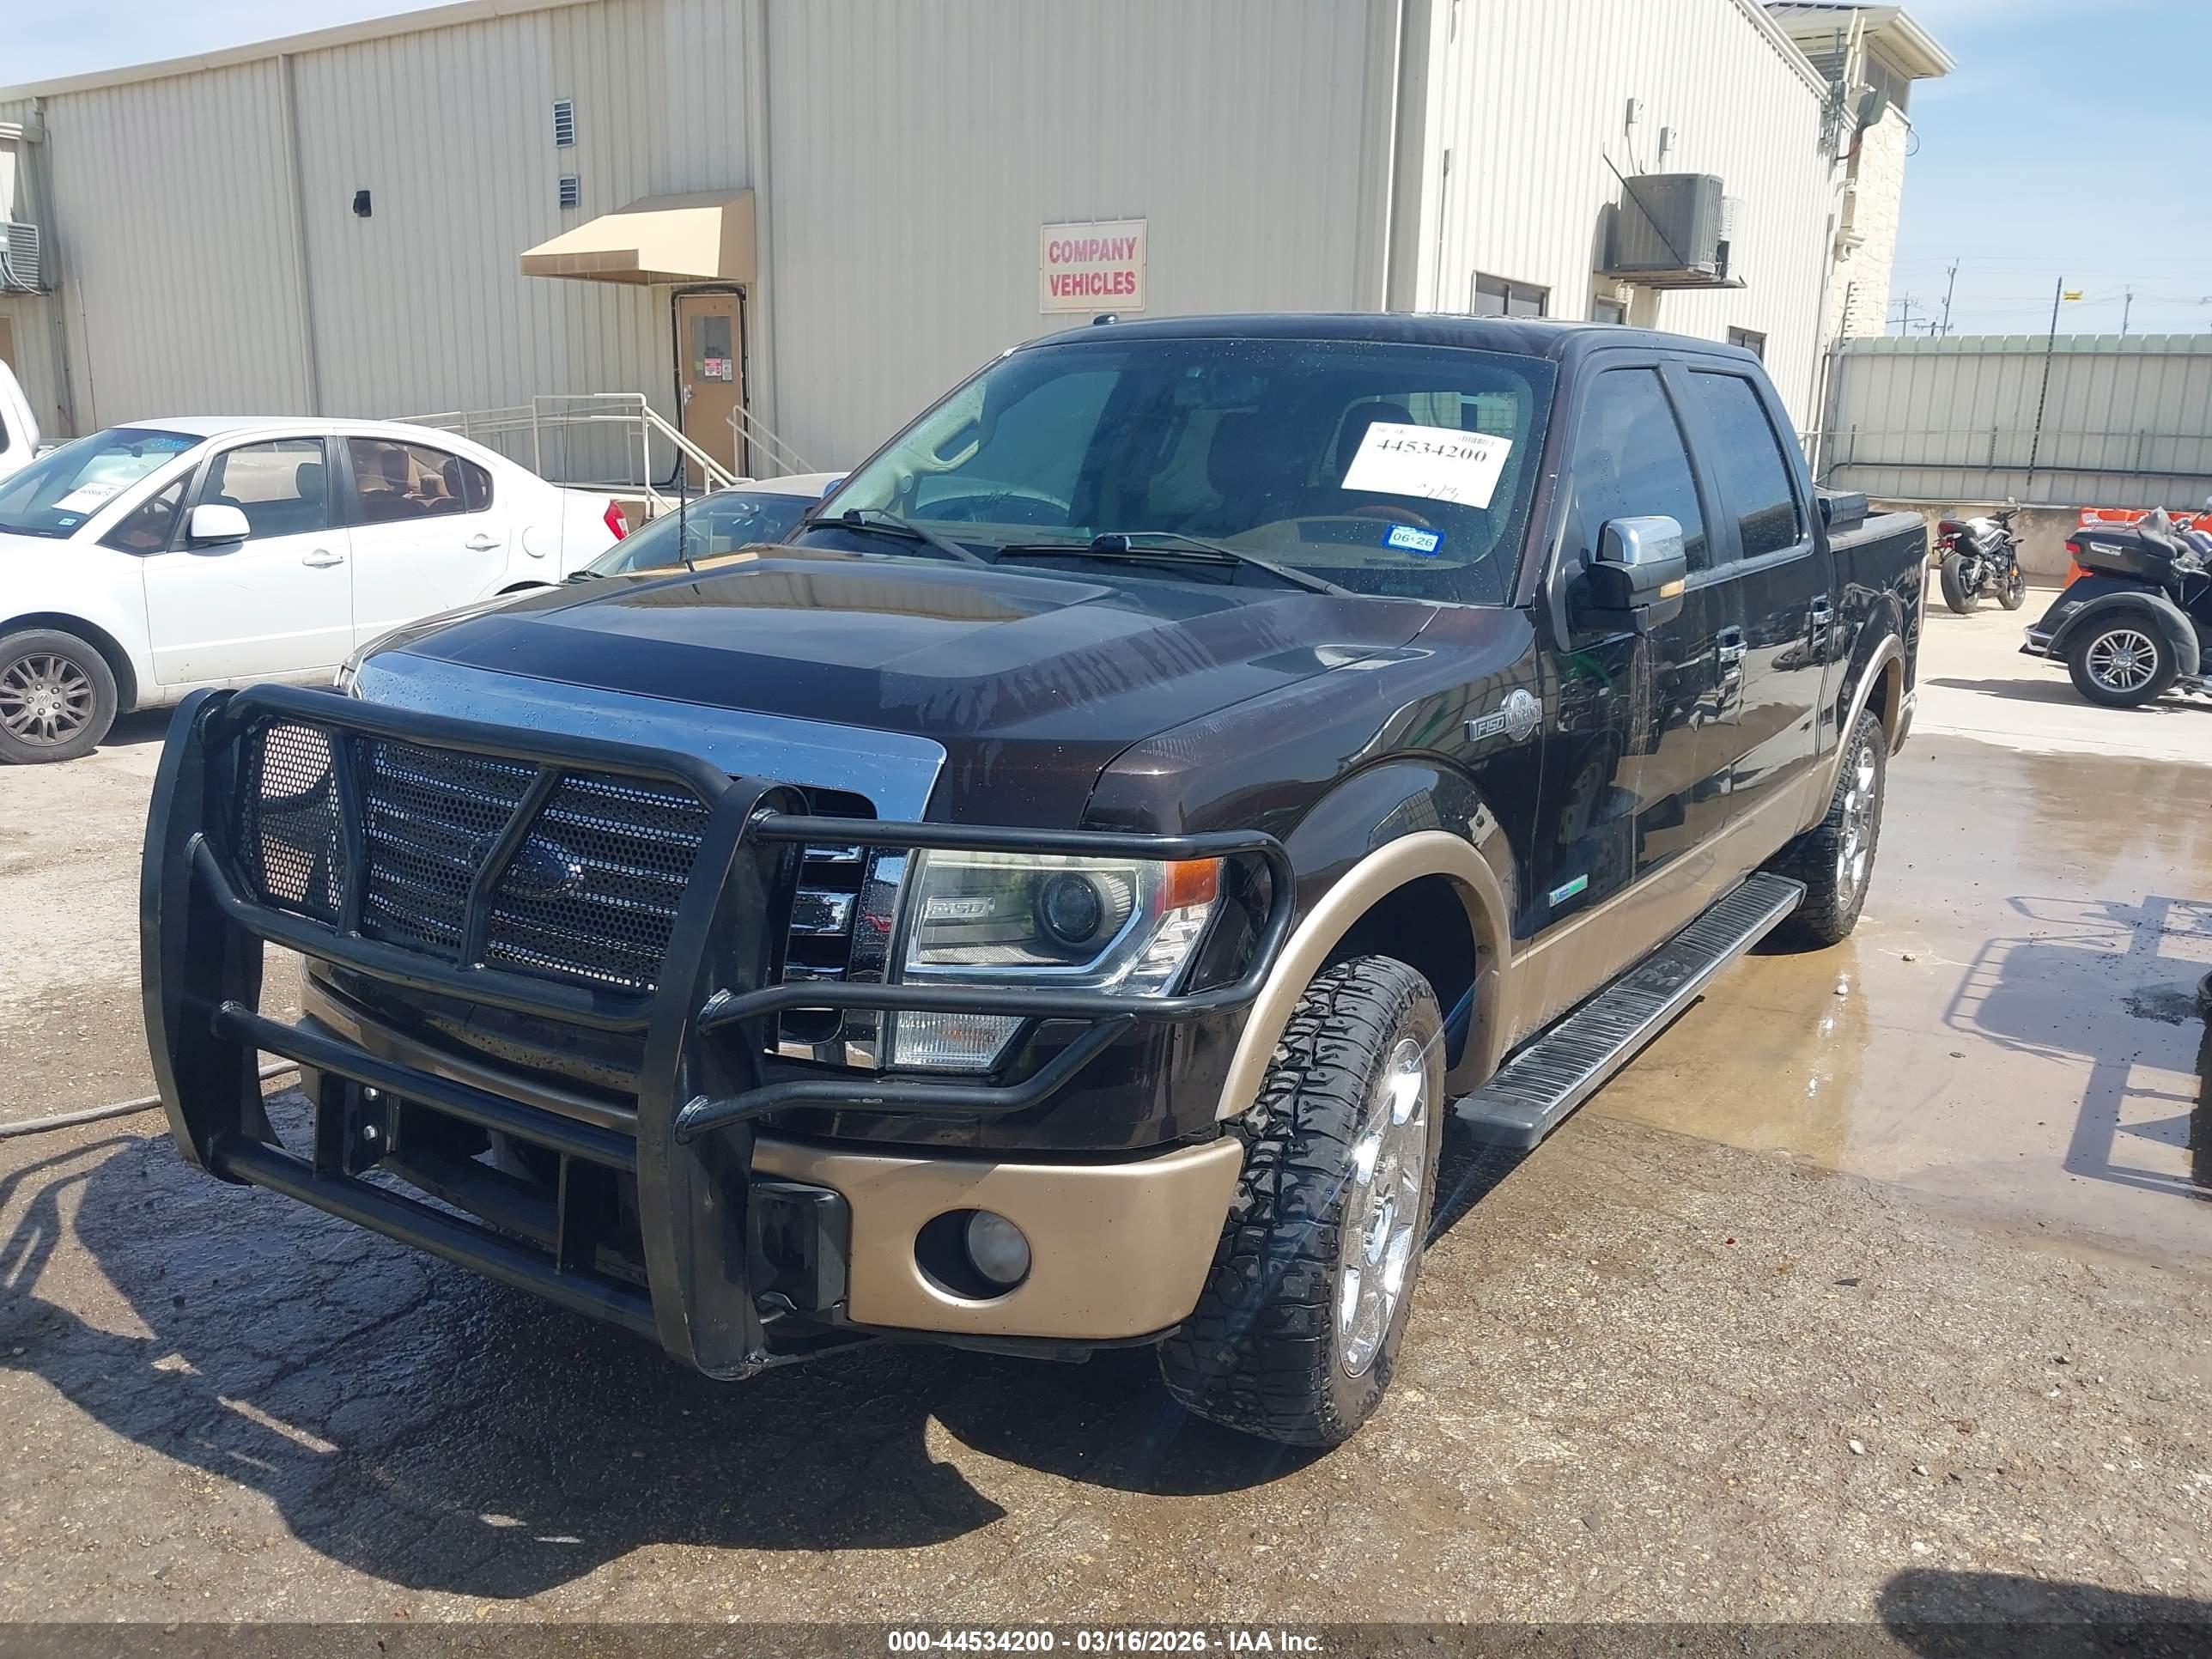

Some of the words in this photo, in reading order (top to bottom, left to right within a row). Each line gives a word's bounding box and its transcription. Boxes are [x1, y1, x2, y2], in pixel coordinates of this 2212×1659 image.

[1048, 237, 1137, 264] COMPANY
[1049, 270, 1136, 296] VEHICLES
[1376, 439, 1487, 463] 44534200
